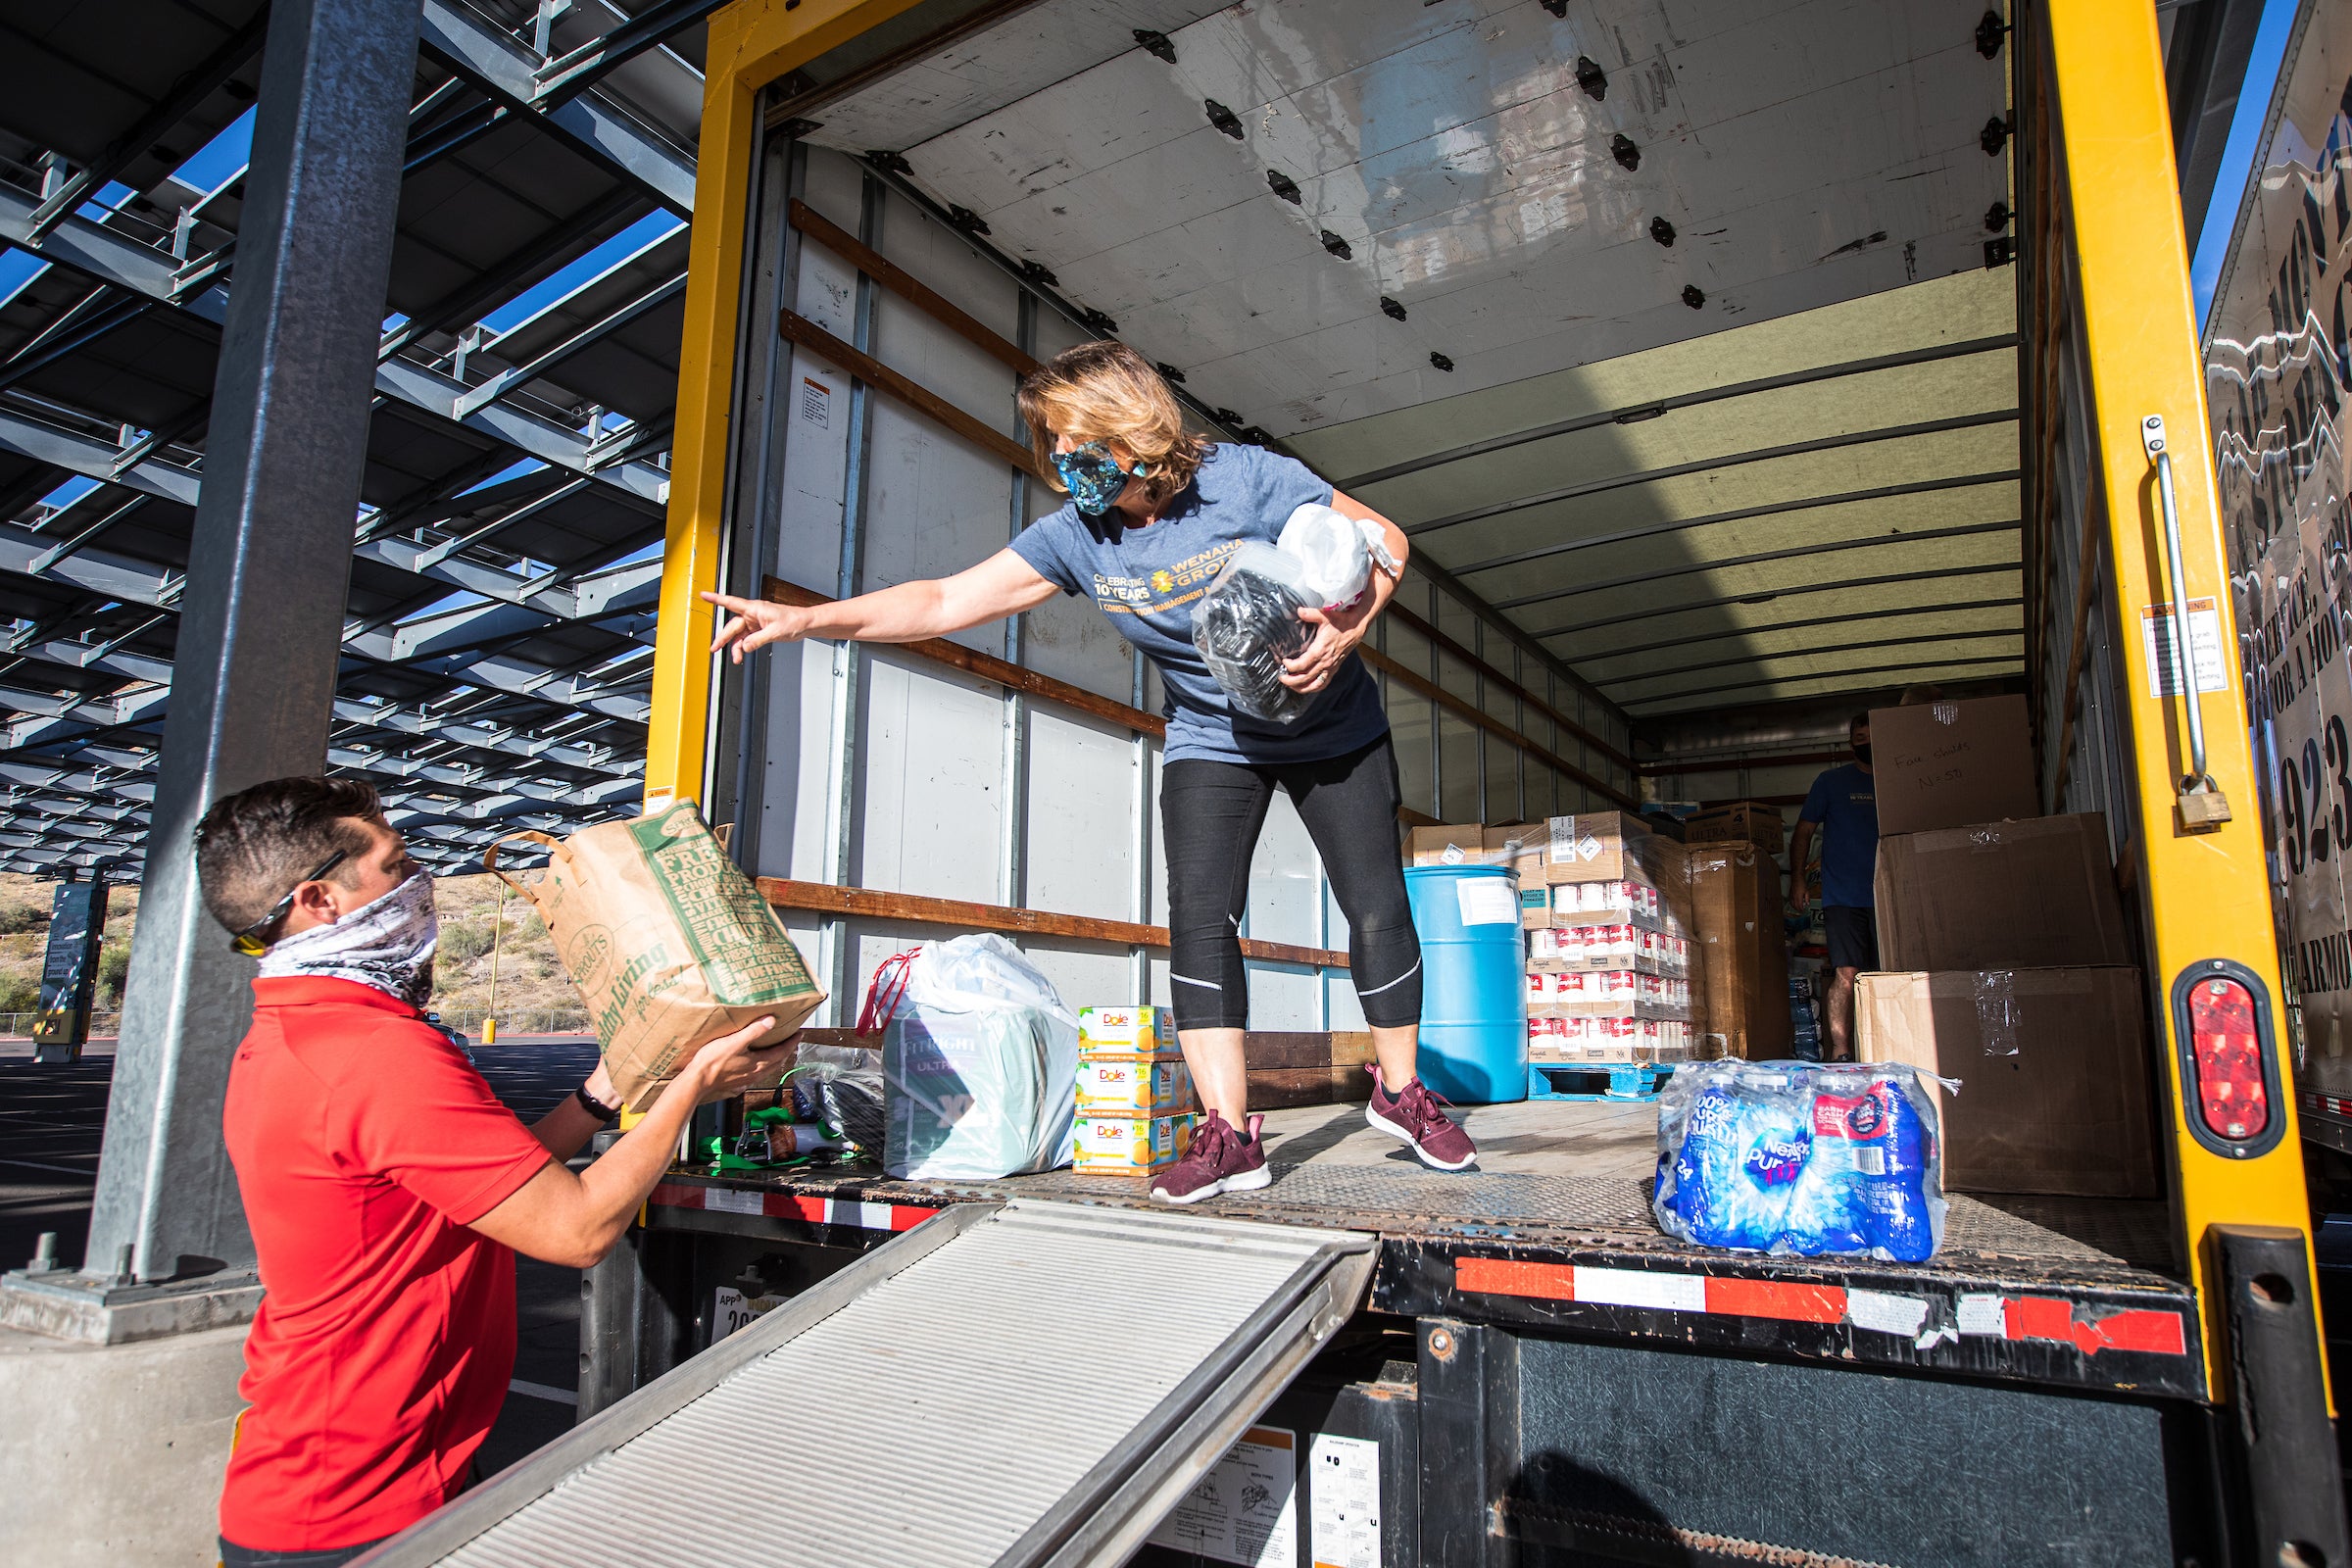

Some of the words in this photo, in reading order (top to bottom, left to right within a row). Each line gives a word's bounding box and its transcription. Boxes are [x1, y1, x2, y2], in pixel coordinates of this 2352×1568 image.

[1171, 539, 1245, 573] WENAHA
[1177, 555, 1233, 586] GROU
[1094, 584, 1109, 596] 10
[1109, 587, 1150, 601] YEARS
[1154, 589, 1203, 612] MANAGEMENT
[2265, 566, 2318, 667] ERVICE,
[2306, 589, 2346, 679] MOV
[666, 816, 697, 835] SPRO
[1691, 826, 1727, 841] ULTRA
[571, 934, 608, 988] SPROUTS
[735, 961, 795, 984] MUFFINS
[2298, 930, 2352, 994] ARMO
[596, 1001, 625, 1054] ealthy
[611, 942, 669, 1010] Living
[634, 995, 649, 1022] for
[1103, 1013, 1128, 1026] Dole
[1100, 1069, 1125, 1082] Dole
[1160, 1068, 1171, 1081] Dole
[1696, 1096, 1731, 1113] 00%
[1098, 1125, 1123, 1138] Dole
[1159, 1123, 1170, 1137] Dole
[1677, 1158, 1693, 1181] 24
[1747, 1149, 1785, 1170] Pur
[719, 1295, 736, 1306] APP
[747, 1298, 783, 1311] INDIA
